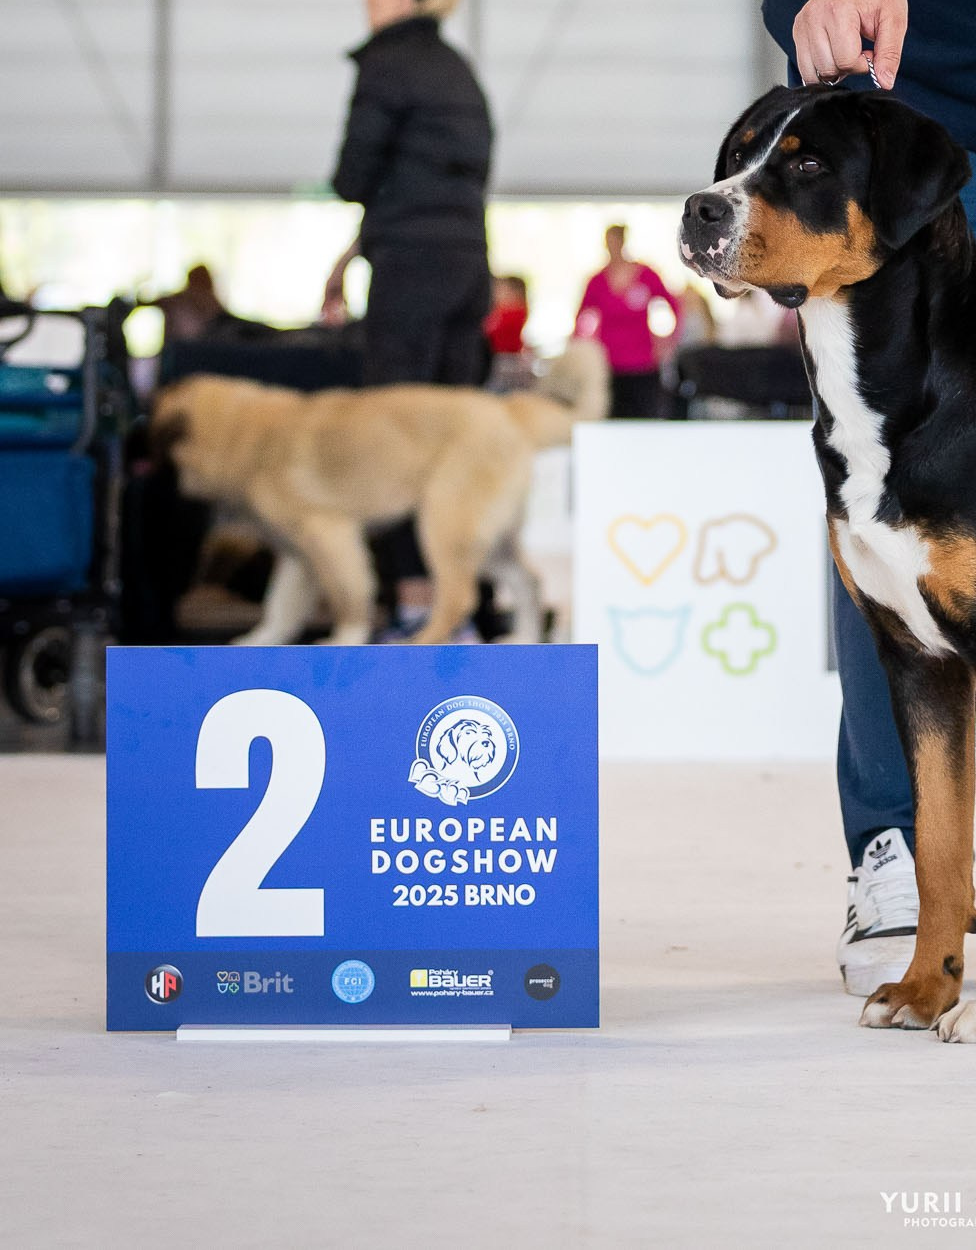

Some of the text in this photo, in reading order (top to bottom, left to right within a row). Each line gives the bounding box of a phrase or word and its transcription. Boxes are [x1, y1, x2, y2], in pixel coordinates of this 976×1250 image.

[421, 709, 446, 747] EUROPEAN
[446, 700, 465, 711] DOG
[468, 700, 491, 711] SHOW
[505, 727, 516, 751] BRNO
[195, 689, 326, 937] 2
[370, 817, 557, 843] EUROPEAN
[371, 848, 558, 874] DOGSHOW
[872, 854, 897, 871] adidas
[392, 883, 536, 906] 2025 BRNO
[152, 971, 177, 998] HP
[243, 971, 294, 993] Brit
[344, 977, 362, 986] FCI
